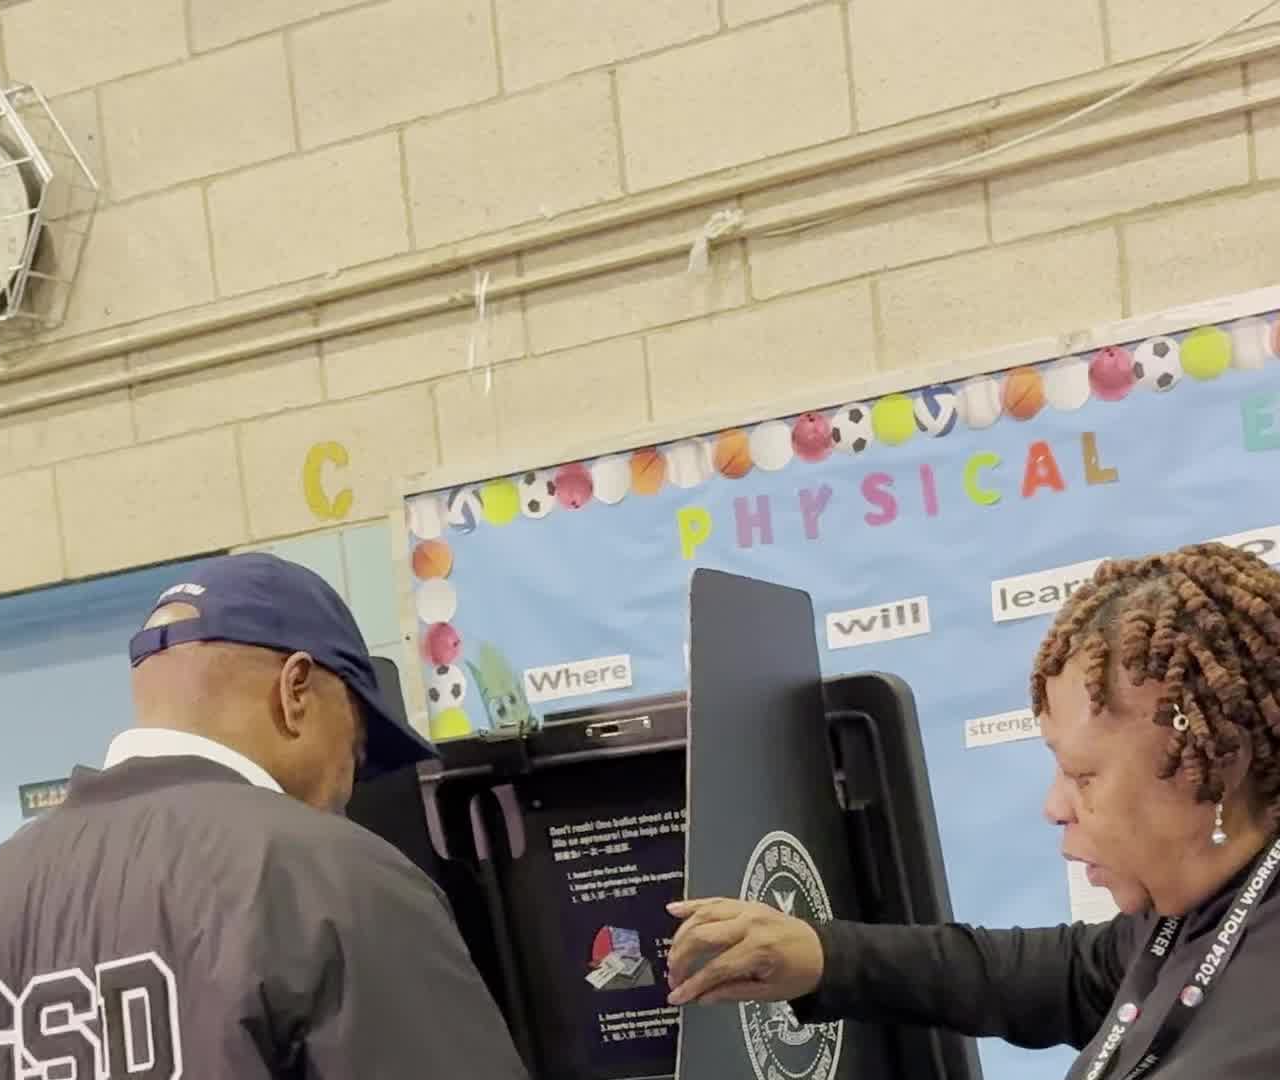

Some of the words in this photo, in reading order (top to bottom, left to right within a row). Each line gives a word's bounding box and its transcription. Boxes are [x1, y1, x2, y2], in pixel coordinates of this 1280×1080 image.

[303, 441, 353, 519] C
[675, 432, 1118, 560] PHYSICAL
[999, 577, 1094, 611] lear
[833, 602, 922, 637] will
[528, 660, 627, 695] Where
[968, 716, 1041, 737] streng
[1150, 915, 1180, 958] RKER
[1195, 943, 1226, 986] 2024
[1217, 908, 1248, 946] POLL
